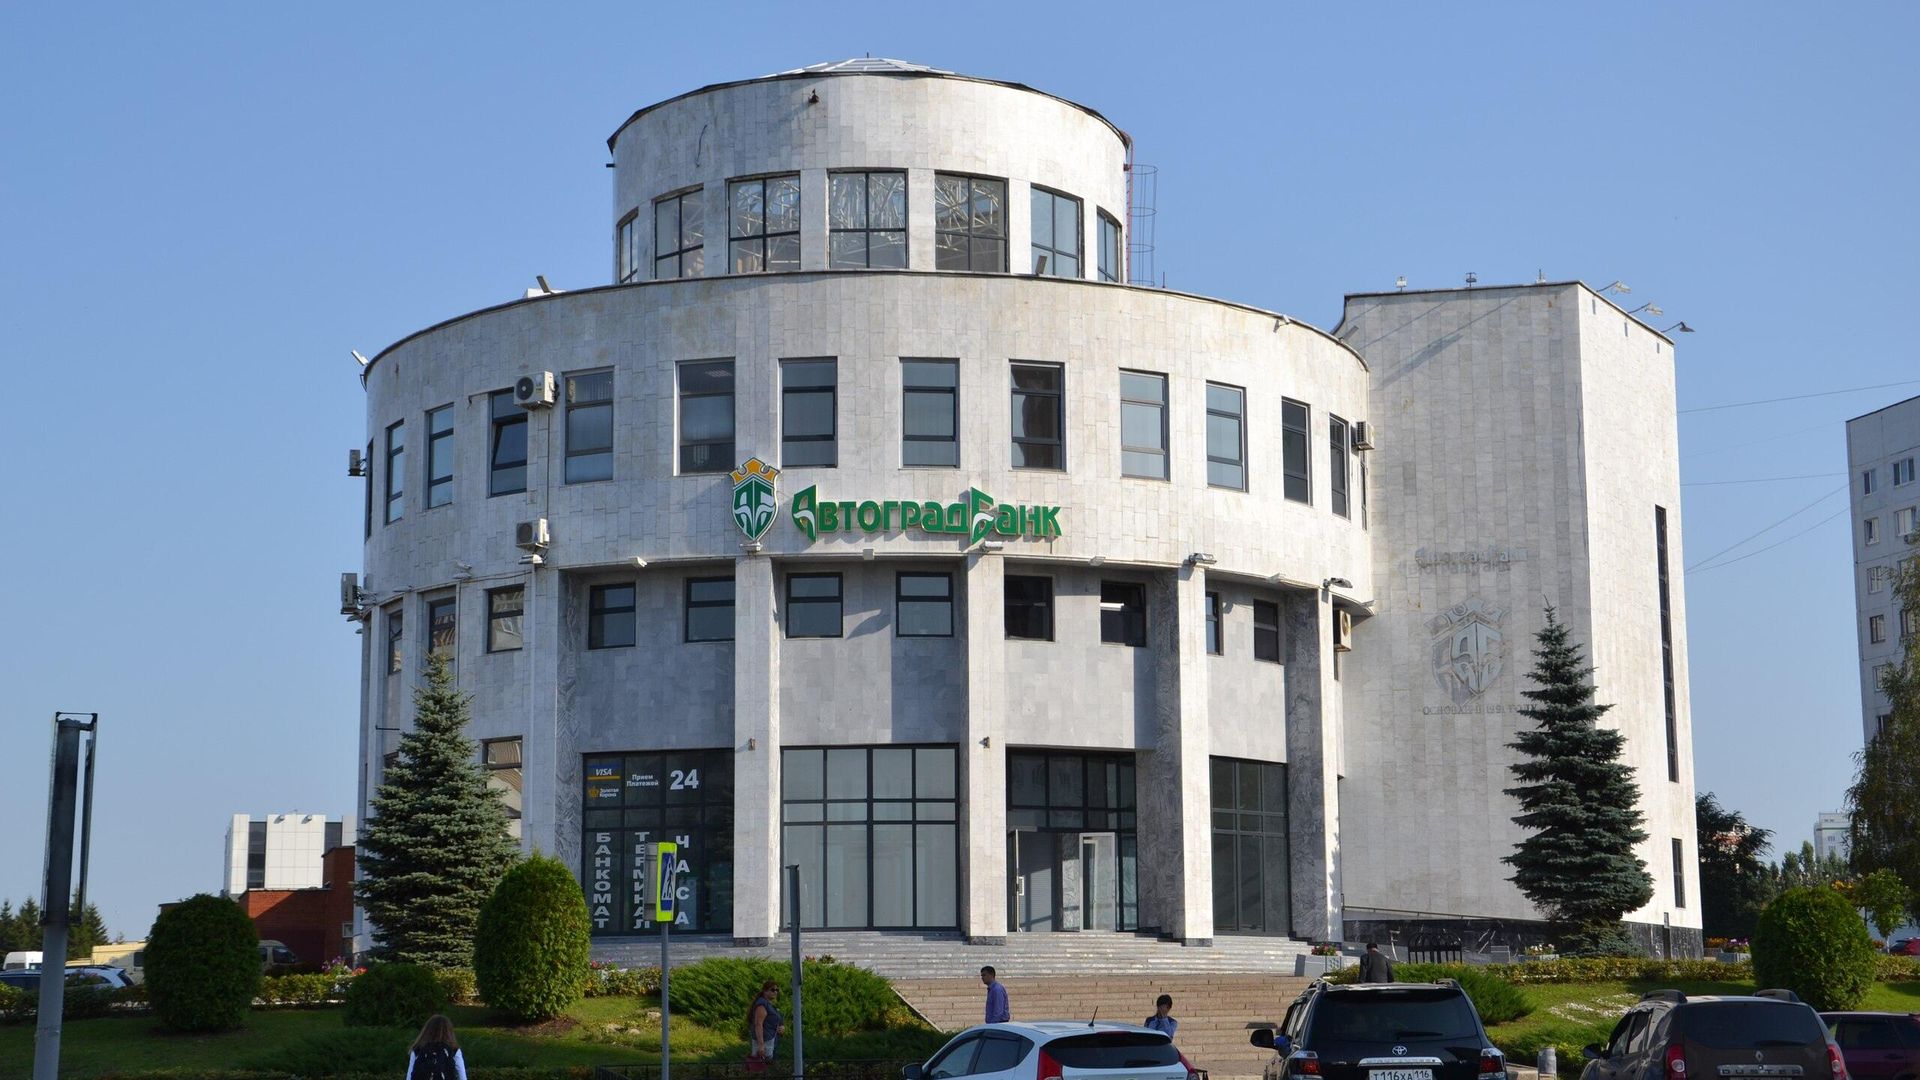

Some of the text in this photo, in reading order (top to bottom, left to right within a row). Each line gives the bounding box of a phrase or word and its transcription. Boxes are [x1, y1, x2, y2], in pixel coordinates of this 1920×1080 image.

[791, 484, 1063, 544] АвтоградБанк
[595, 768, 613, 776] VISA
[670, 769, 699, 790] 24
[593, 832, 611, 929] БАНКОМАТ
[674, 835, 691, 925] ЧАСА
[1414, 1070, 1430, 1078] 116
